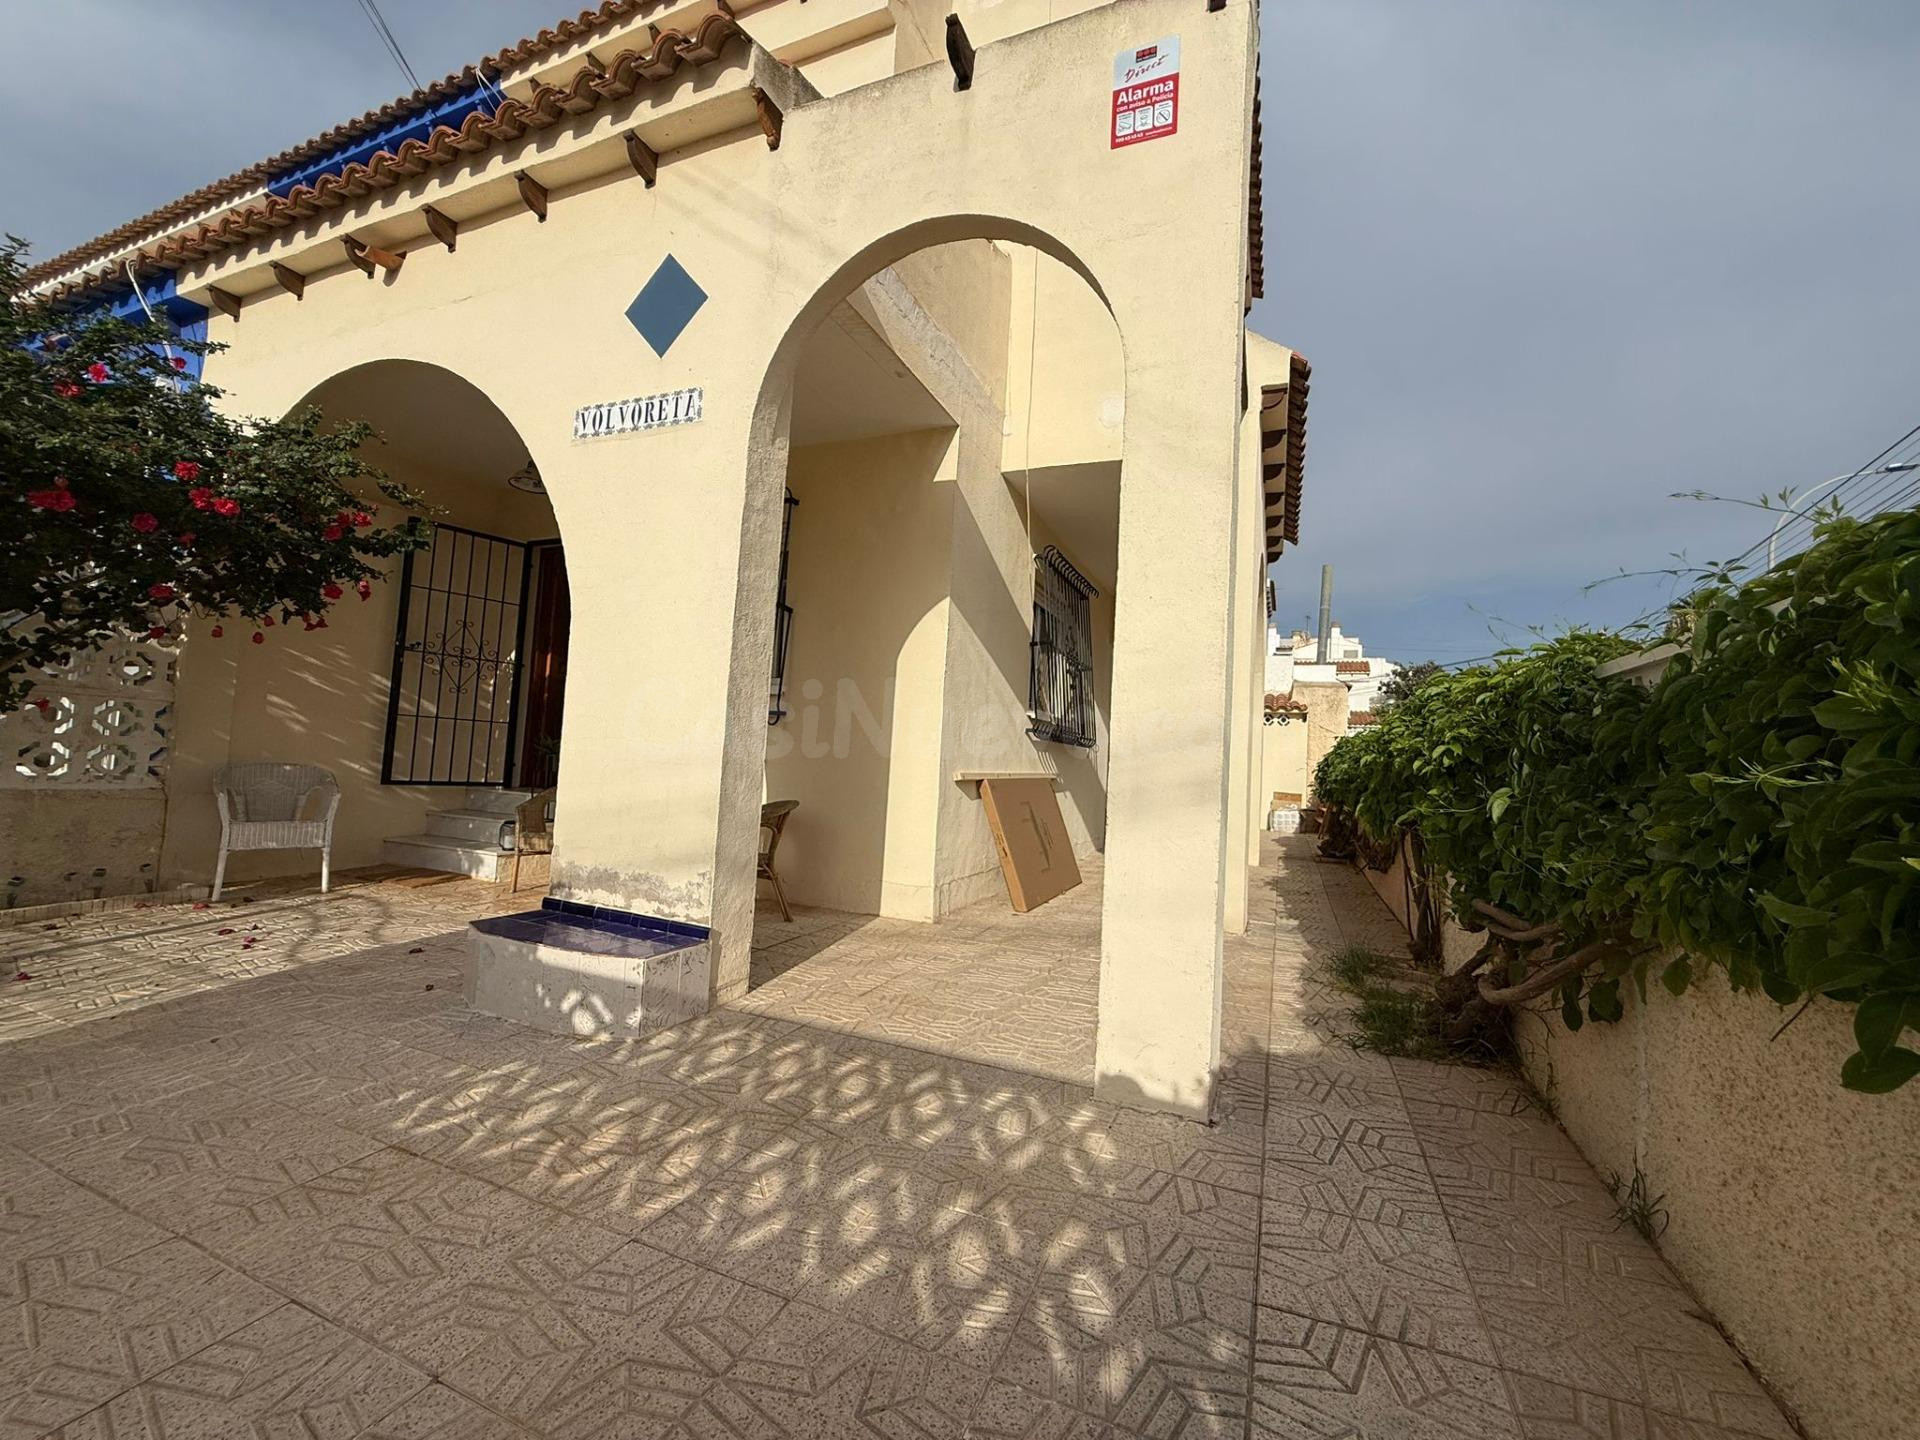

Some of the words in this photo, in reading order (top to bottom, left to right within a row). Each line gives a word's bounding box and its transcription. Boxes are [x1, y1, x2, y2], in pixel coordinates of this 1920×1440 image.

[1120, 53, 1169, 83] Direct
[1117, 80, 1174, 105] Alarma
[580, 394, 697, 432] VOLVORETA
